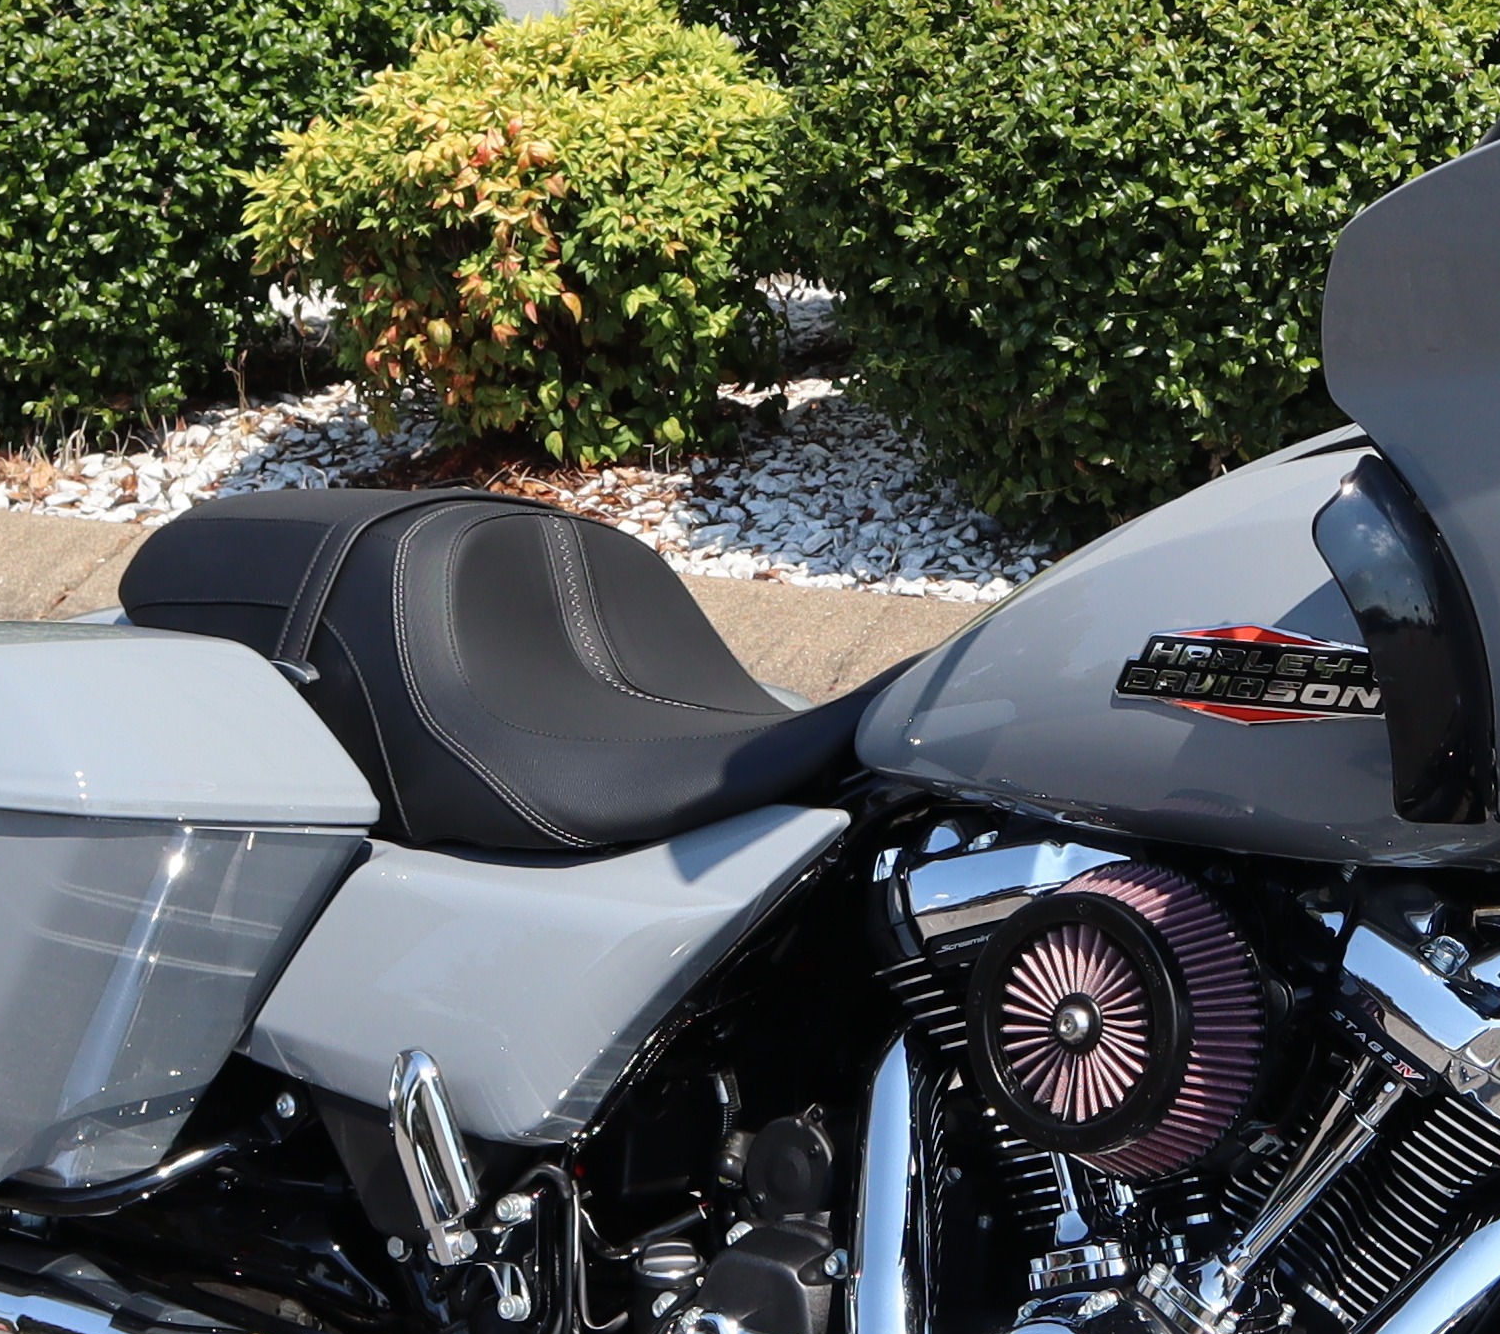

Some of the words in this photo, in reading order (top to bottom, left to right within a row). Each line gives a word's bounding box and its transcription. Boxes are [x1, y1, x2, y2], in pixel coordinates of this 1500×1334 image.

[1148, 642, 1368, 679] HARLEY-
[1124, 667, 1382, 709] DAVIDSON
[1329, 1010, 1397, 1064] STAGE
